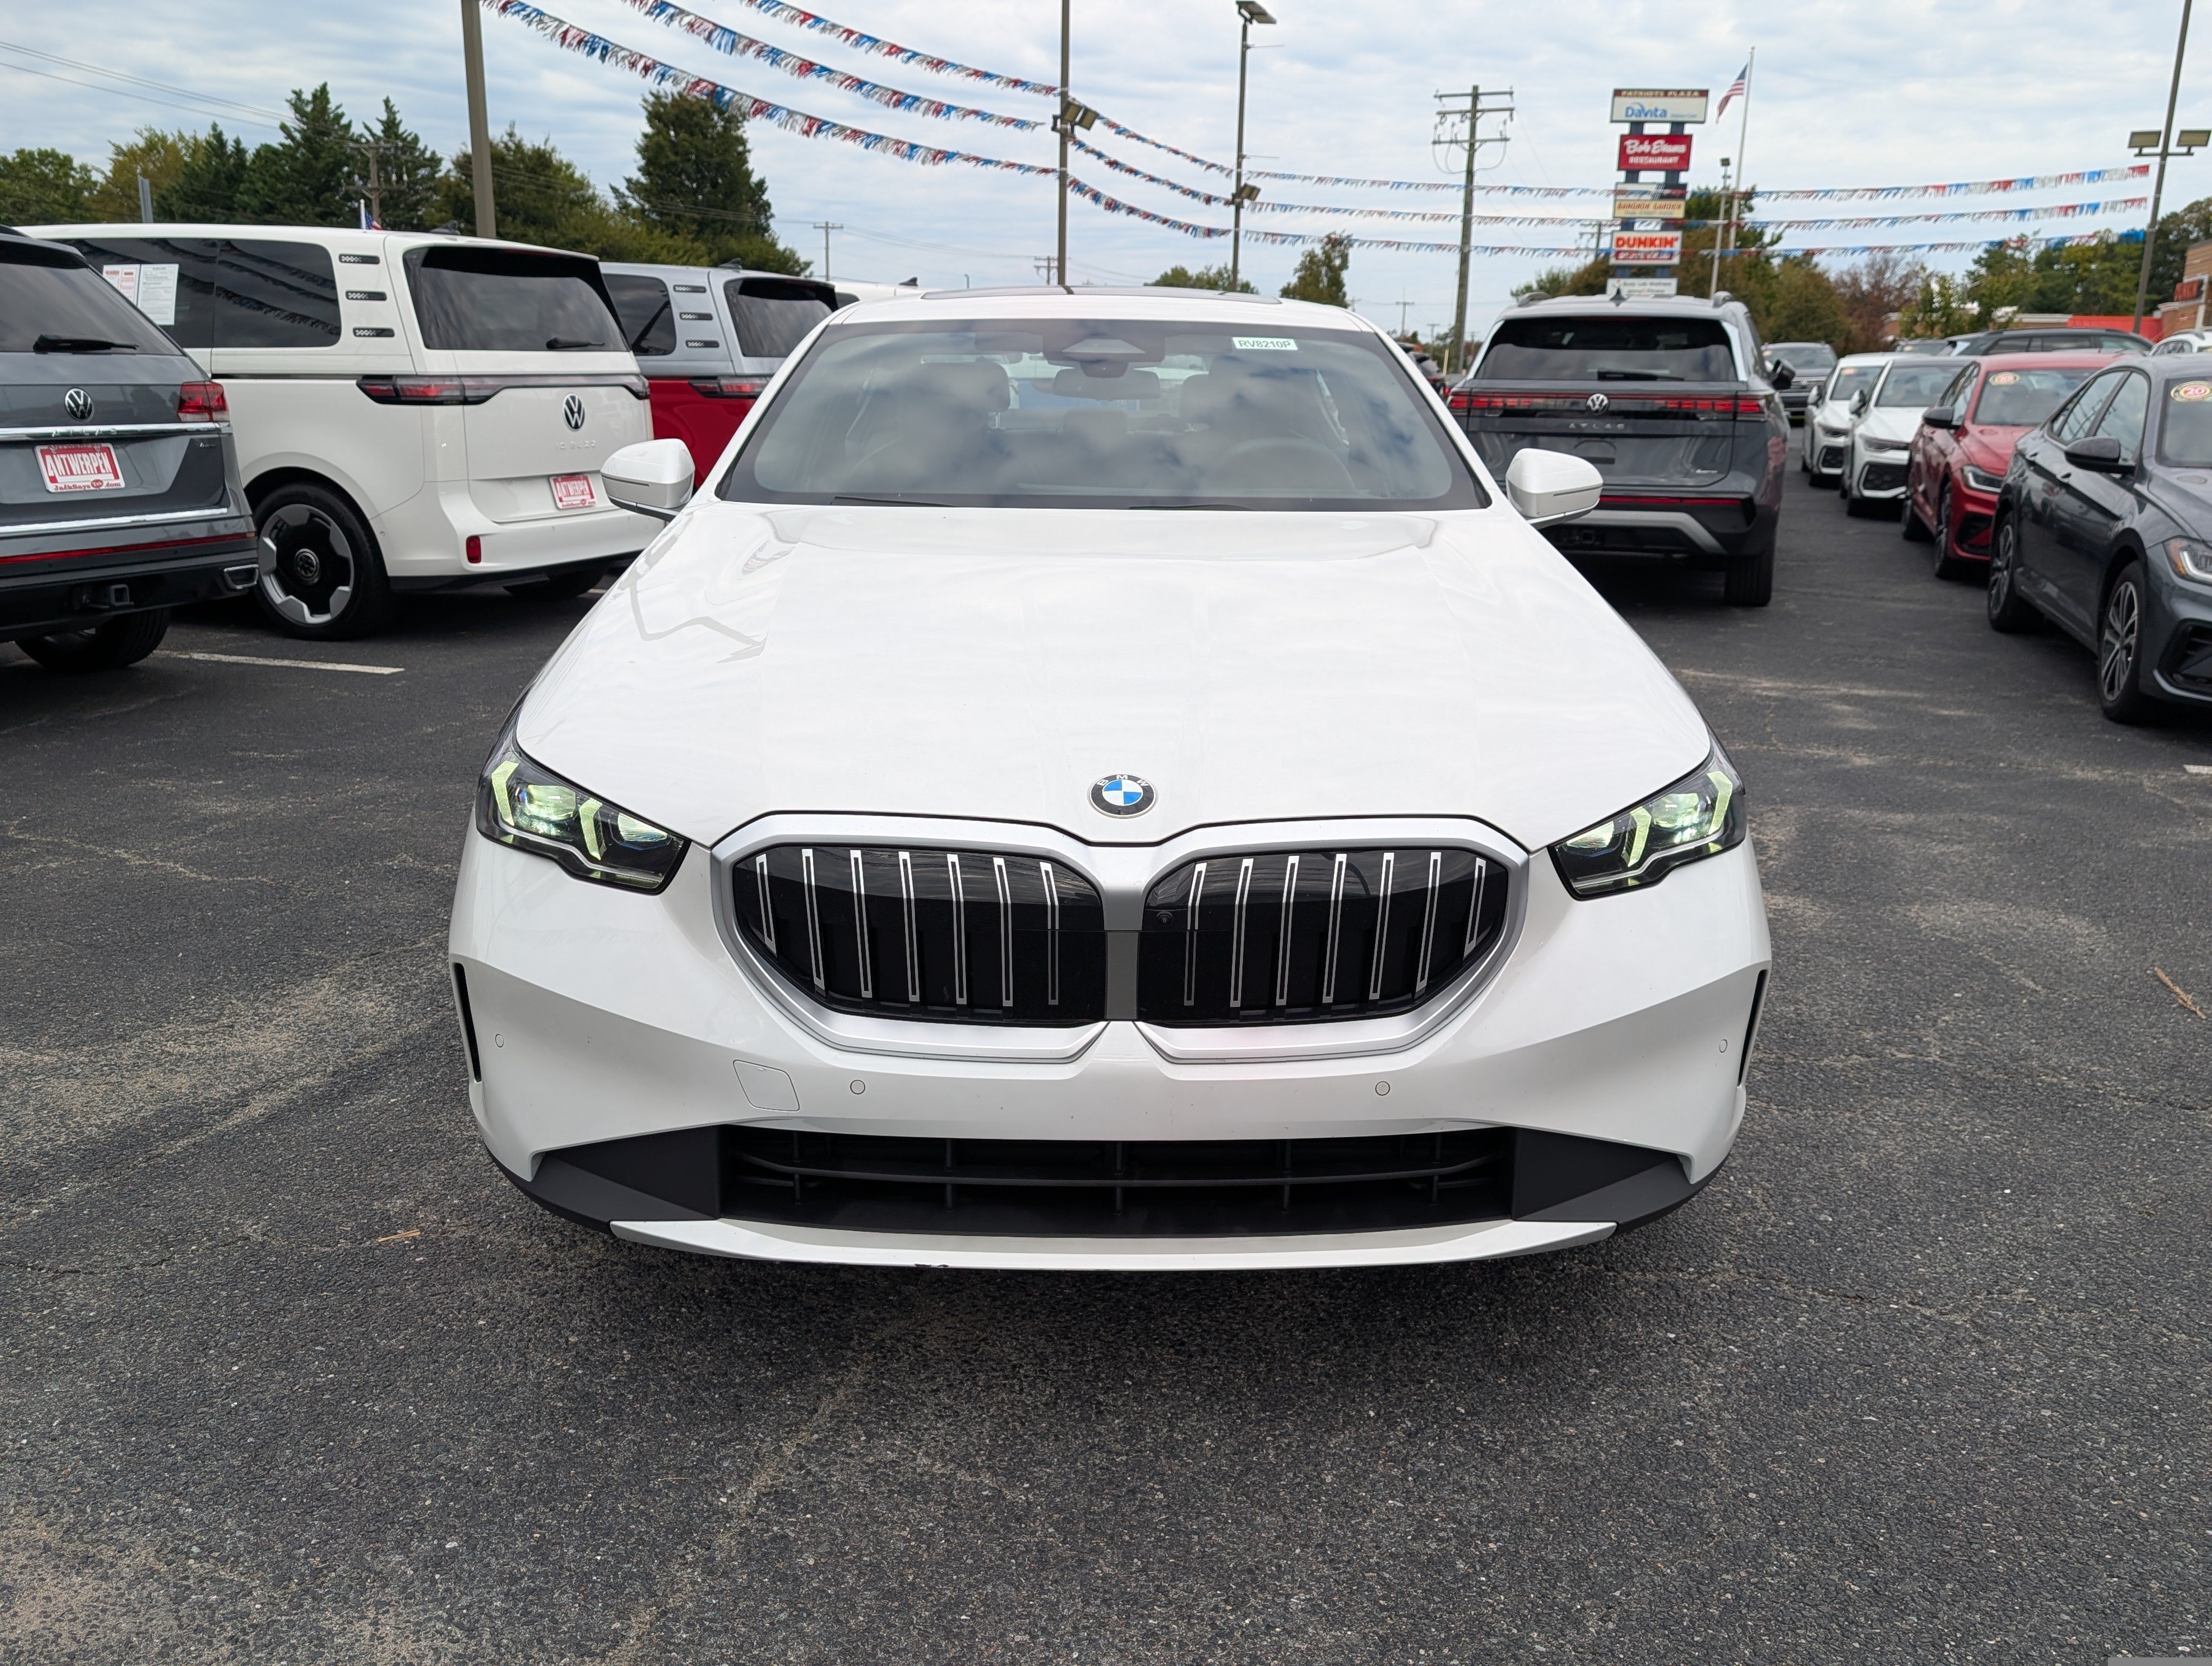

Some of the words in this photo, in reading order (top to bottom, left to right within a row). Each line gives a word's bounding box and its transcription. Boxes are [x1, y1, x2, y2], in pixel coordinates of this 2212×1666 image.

[1625, 105, 1668, 118] DaVita
[1624, 139, 1651, 155] Bob
[1651, 139, 1687, 155] Evans
[1628, 156, 1680, 164] RESTAURANT
[1616, 236, 1679, 248] DUNKIN'
[1238, 339, 1291, 348] RV8210P
[52, 428, 117, 437] ATLAS
[44, 452, 113, 476] ANTWERPEN
[1096, 774, 1149, 786] BMW
